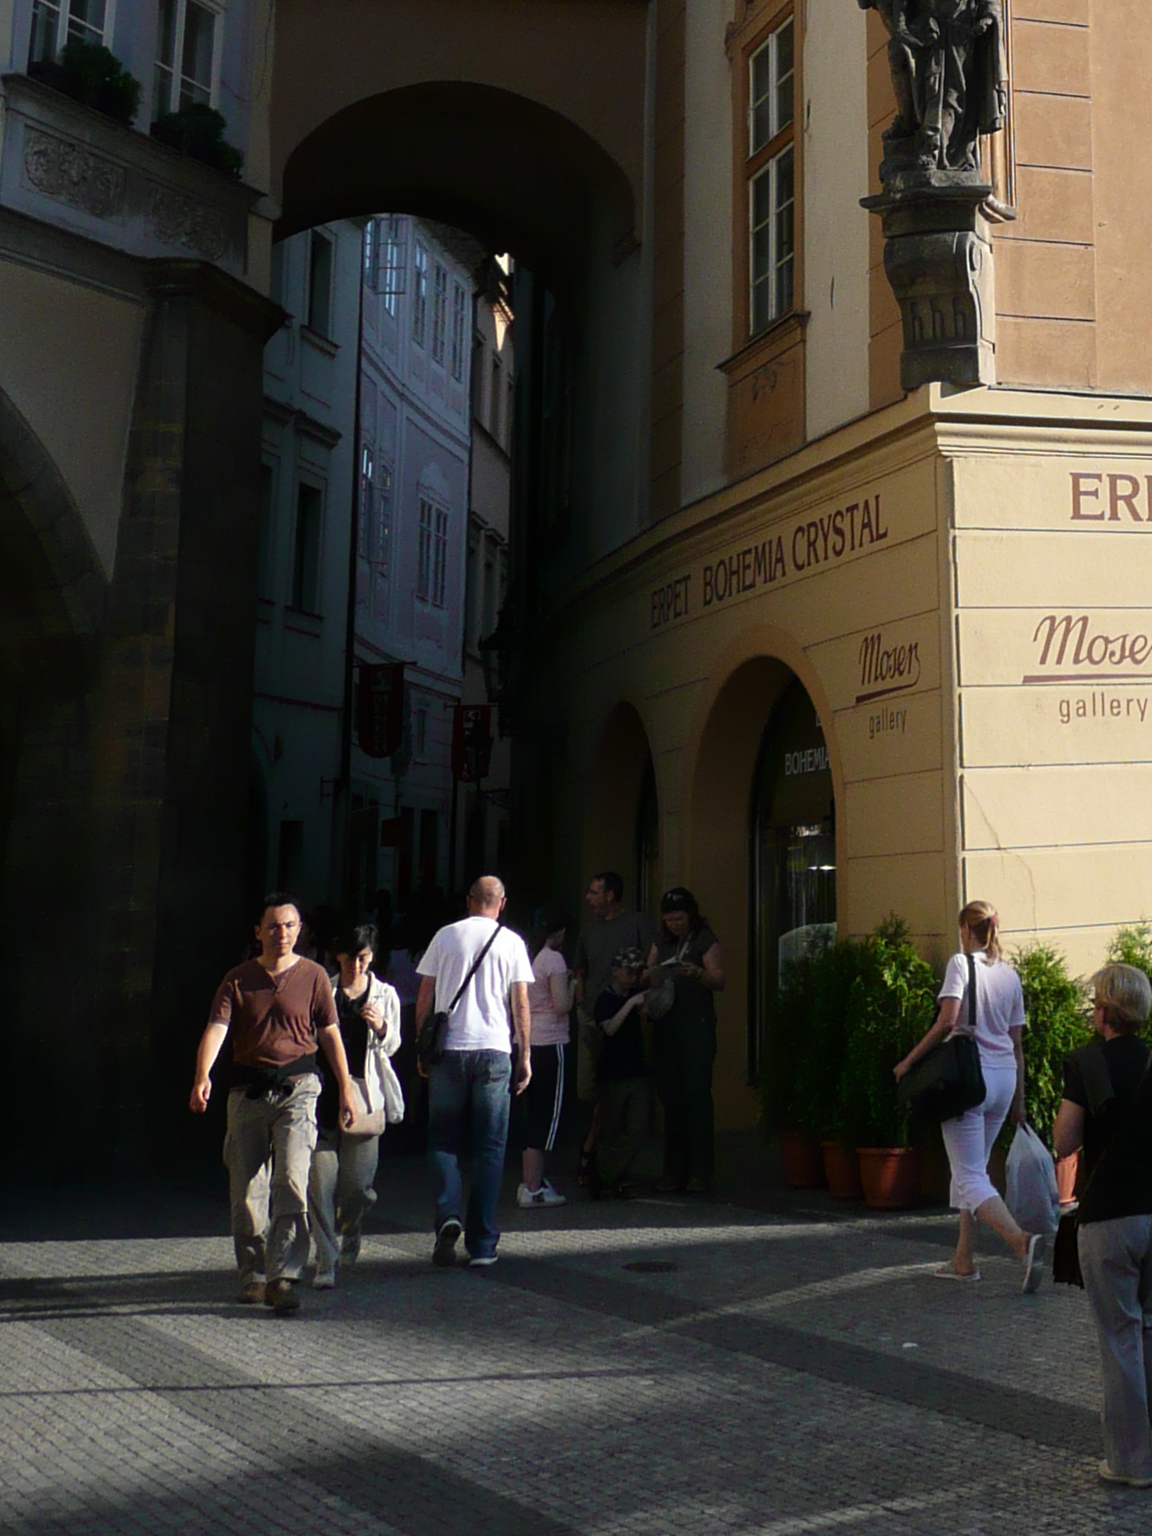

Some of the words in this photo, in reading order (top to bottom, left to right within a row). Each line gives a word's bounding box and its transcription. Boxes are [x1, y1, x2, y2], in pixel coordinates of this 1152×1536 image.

[650, 574, 692, 630] ERPET
[703, 535, 787, 607] BOHEMIA
[791, 493, 888, 572] CRYSTAL
[857, 632, 921, 700] Moser
[869, 707, 907, 740] gallery
[1058, 691, 1149, 725] gallery
